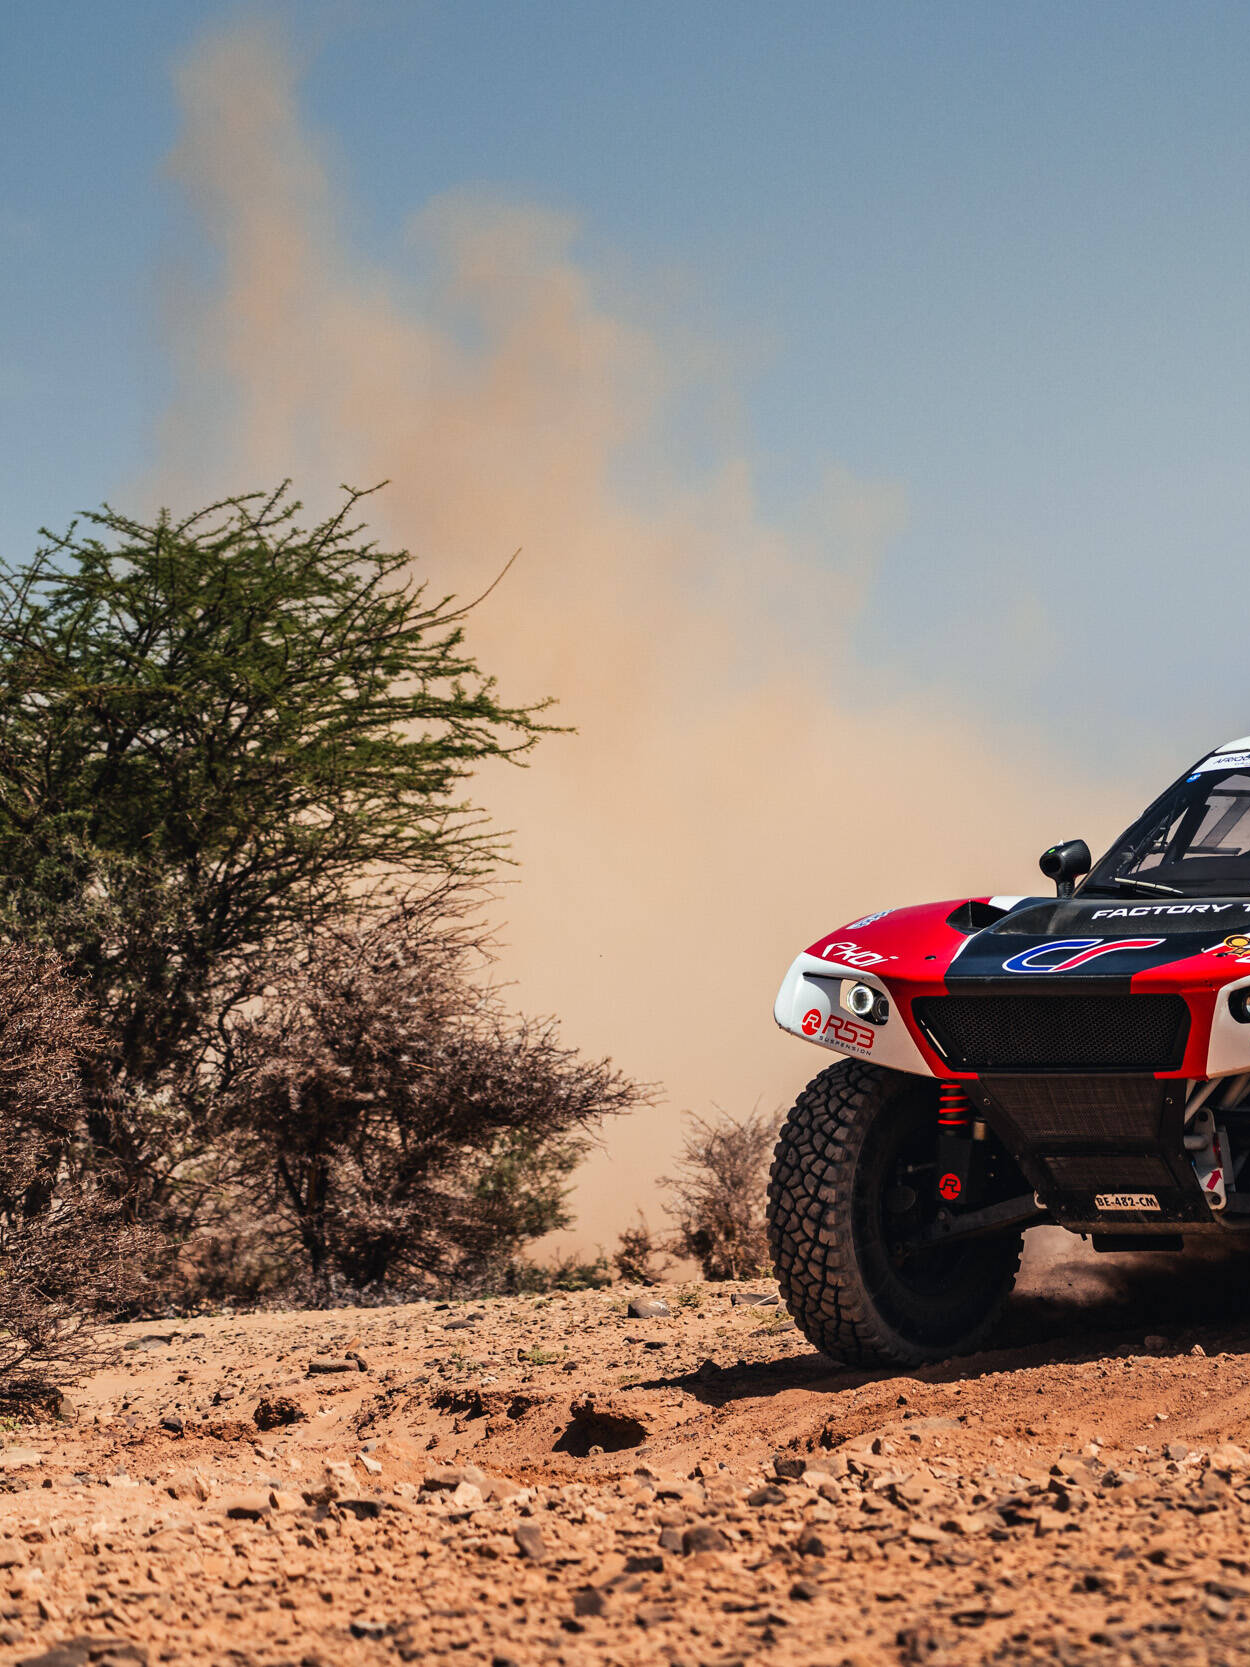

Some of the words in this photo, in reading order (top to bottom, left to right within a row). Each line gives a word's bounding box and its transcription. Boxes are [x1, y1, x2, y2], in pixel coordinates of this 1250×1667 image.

[1092, 904, 1231, 920] FACTORY
[821, 1014, 875, 1049] R53
[819, 1035, 872, 1056] SUSPENSION
[1095, 1197, 1159, 1208] BE-482-CM
